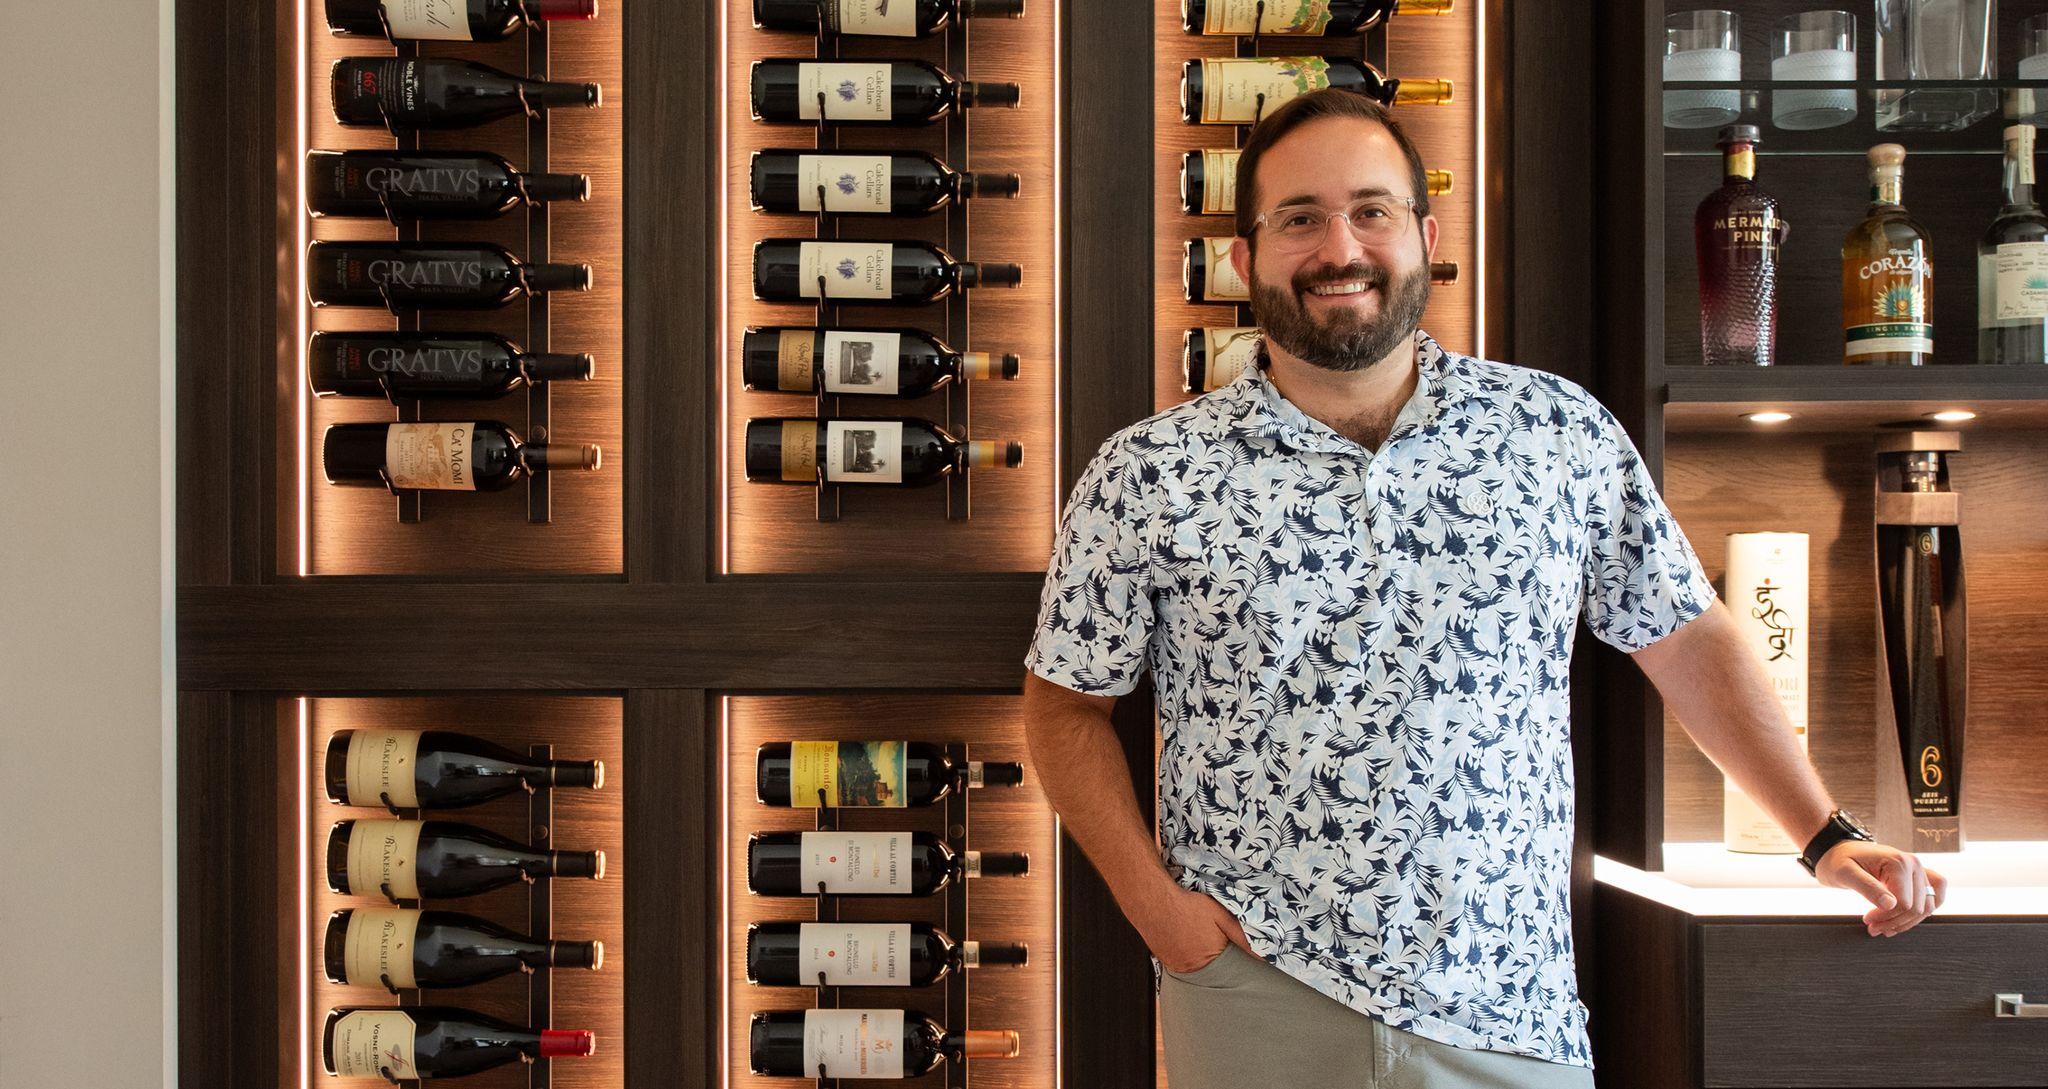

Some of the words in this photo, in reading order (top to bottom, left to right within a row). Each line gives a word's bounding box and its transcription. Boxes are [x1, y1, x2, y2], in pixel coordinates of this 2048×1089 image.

[405, 61, 415, 84] NOBLE
[405, 86, 415, 111] VINES
[866, 76, 875, 105] Cellars
[875, 70, 885, 112] Cakebread
[365, 167, 480, 197] GRATVS
[866, 170, 875, 198] Cellars
[875, 163, 885, 205] Cakebread
[1713, 216, 1782, 230] MERMAID
[1733, 230, 1773, 242] PINK
[367, 259, 482, 290] GRATVS
[866, 255, 875, 283] Cellars
[875, 249, 885, 291] Cakebread
[367, 347, 482, 377] GRATVS
[451, 449, 464, 485] MOMI
[1772, 677, 1799, 690] DRI
[382, 736, 398, 788] BLAKESLEE
[1920, 745, 1943, 787] 6
[382, 836, 398, 883] BLAKESLE
